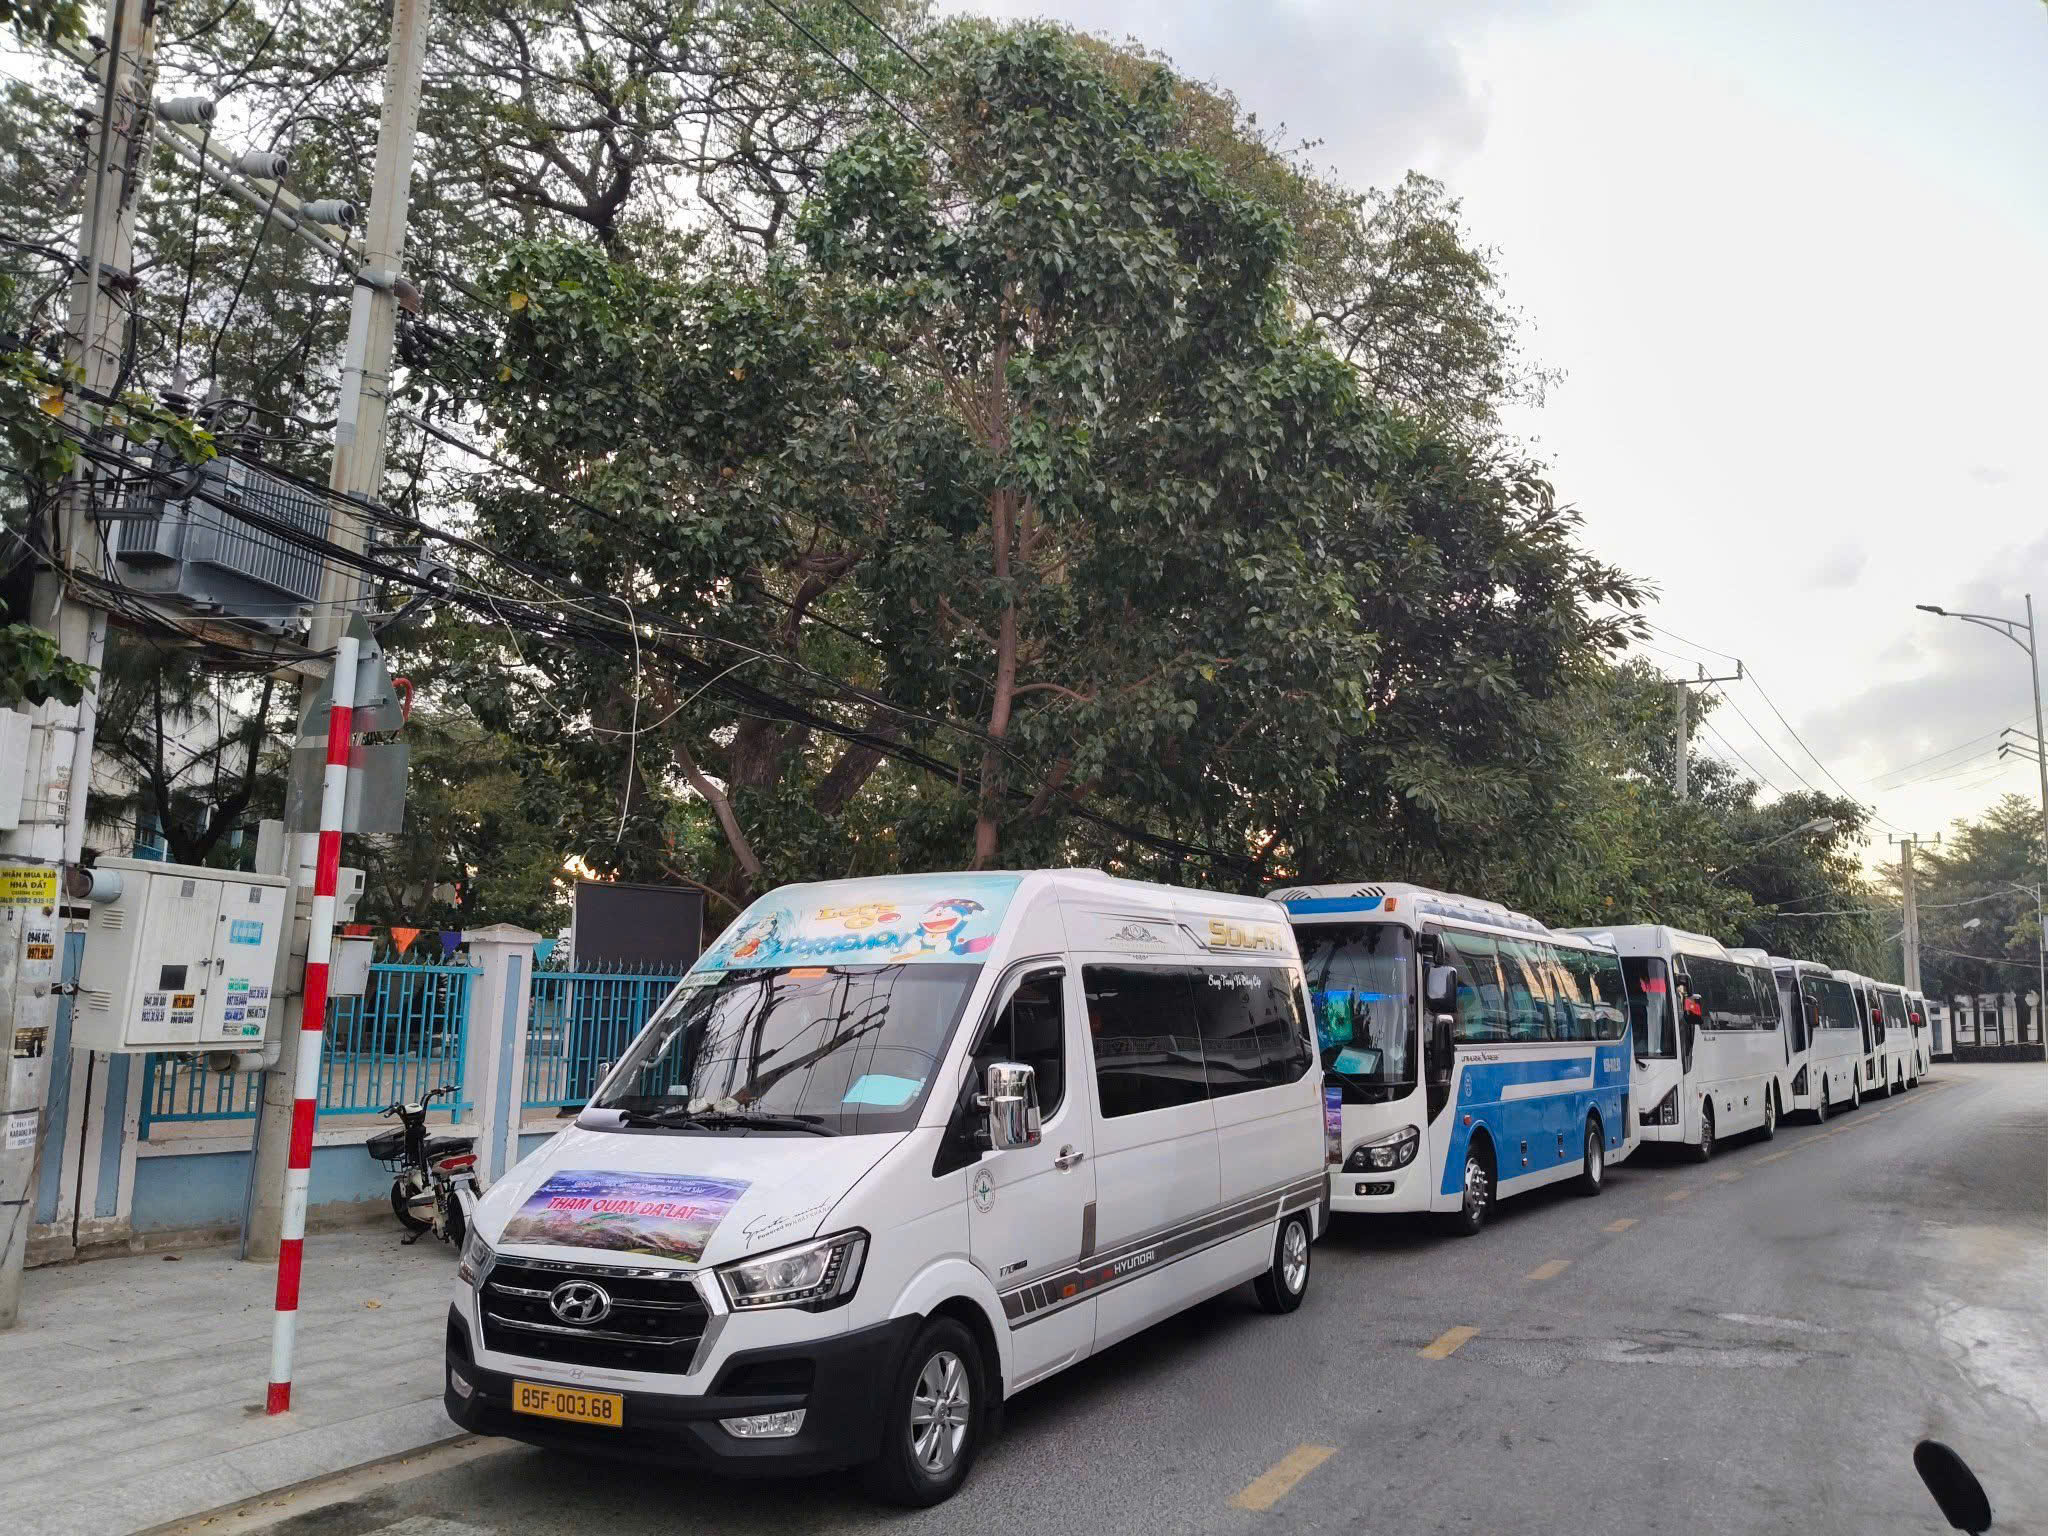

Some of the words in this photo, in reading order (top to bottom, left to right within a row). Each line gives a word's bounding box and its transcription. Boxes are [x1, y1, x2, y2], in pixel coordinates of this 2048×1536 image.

[24, 871, 41, 879] MUA
[547, 1197, 593, 1212] THAM
[592, 1199, 641, 1214] QUAN
[757, 1224, 784, 1241] Powered
[1114, 1251, 1155, 1274] HYUNDAI
[521, 1388, 612, 1419] 85F-003.68
